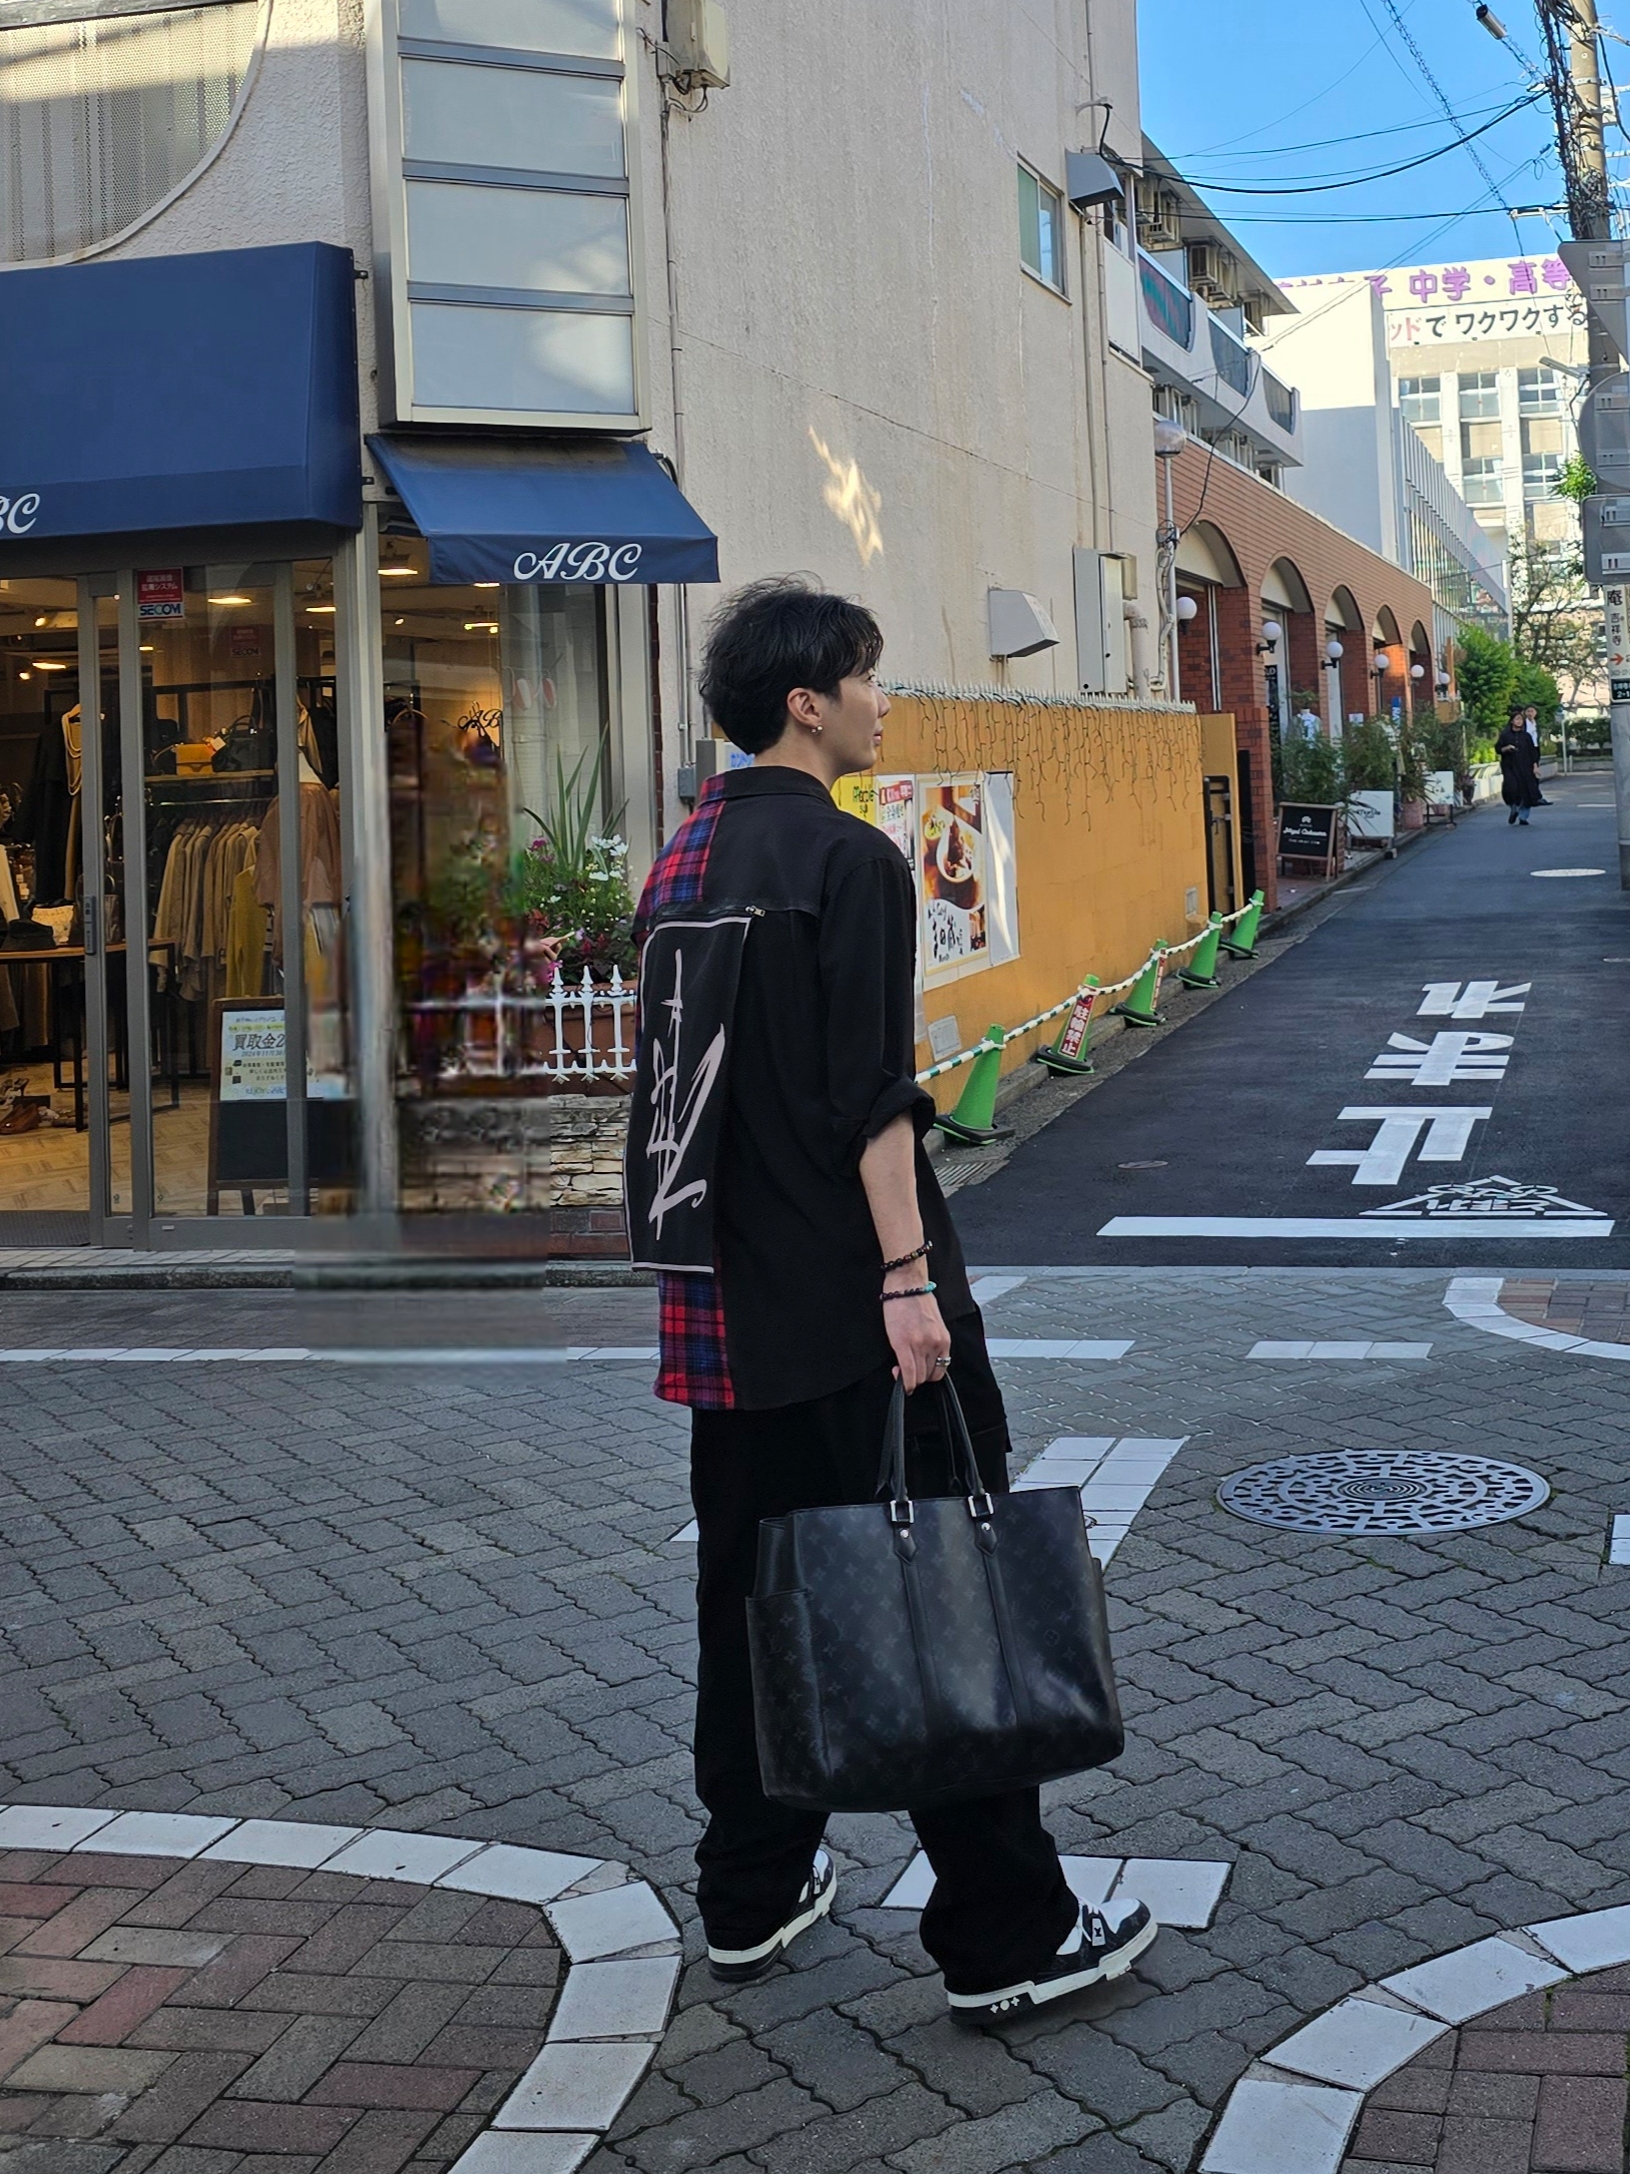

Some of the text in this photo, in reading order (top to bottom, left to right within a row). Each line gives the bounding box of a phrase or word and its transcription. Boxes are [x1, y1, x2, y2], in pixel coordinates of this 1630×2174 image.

[513, 542, 643, 581] ABC
[140, 603, 181, 616] SECOM
[1610, 612, 1622, 646] 吉祥寺
[1062, 1005, 1090, 1057] 駐輪禁止
[1305, 980, 1532, 1186] 止まれ
